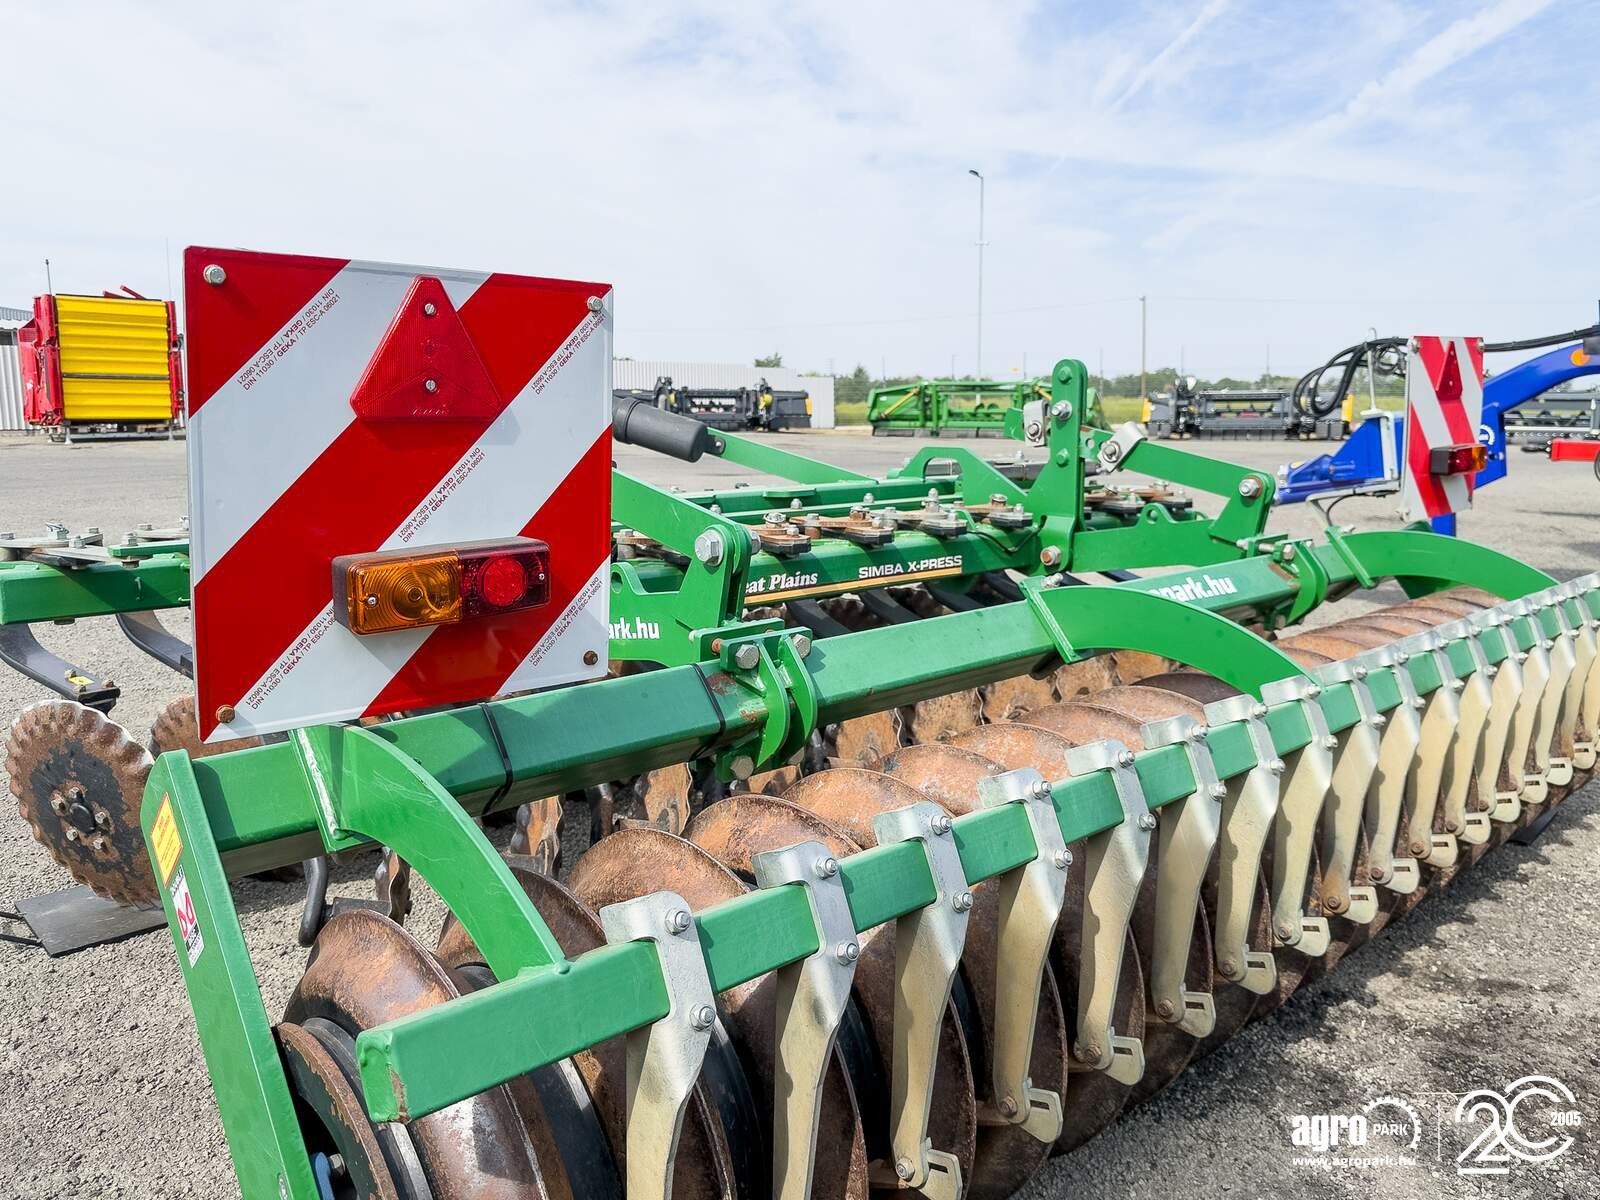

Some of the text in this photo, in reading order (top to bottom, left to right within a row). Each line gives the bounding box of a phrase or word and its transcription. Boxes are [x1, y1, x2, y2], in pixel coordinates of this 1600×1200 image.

[322, 288, 335, 301] DIN
[304, 300, 323, 317] 11030
[282, 320, 303, 338] GEKA
[242, 377, 256, 391] DIN
[256, 359, 274, 377] 11030
[276, 339, 296, 357] GEKA
[298, 326, 307, 336] TP
[306, 310, 326, 329] ESC-A
[323, 294, 341, 312] 06021
[273, 341, 282, 351] TP
[253, 349, 274, 367] ESC-A
[237, 366, 256, 385] 06021
[469, 447, 481, 460] DIN
[455, 459, 470, 475] 11030
[437, 477, 454, 495] GEKA
[402, 530, 414, 543] DIN
[414, 514, 429, 531] 11030
[431, 494, 448, 512] GEKA
[449, 482, 457, 492] TP
[456, 467, 473, 485] ESC-A
[470, 452, 486, 469] 06021
[428, 497, 436, 507] TP
[411, 504, 429, 522] ESC-A
[398, 521, 413, 538] 06021
[858, 563, 904, 579] SIMBA
[768, 571, 818, 591] Plains
[309, 617, 327, 635] 11030
[289, 637, 308, 656] GEKA
[251, 696, 264, 710] DIN
[264, 678, 281, 696] 11030
[283, 656, 302, 675] GEKA
[303, 642, 312, 652] TP
[311, 625, 330, 644] ESC-A
[279, 660, 288, 669] TP
[261, 668, 280, 688] ESC-A
[245, 687, 263, 706] 06021
